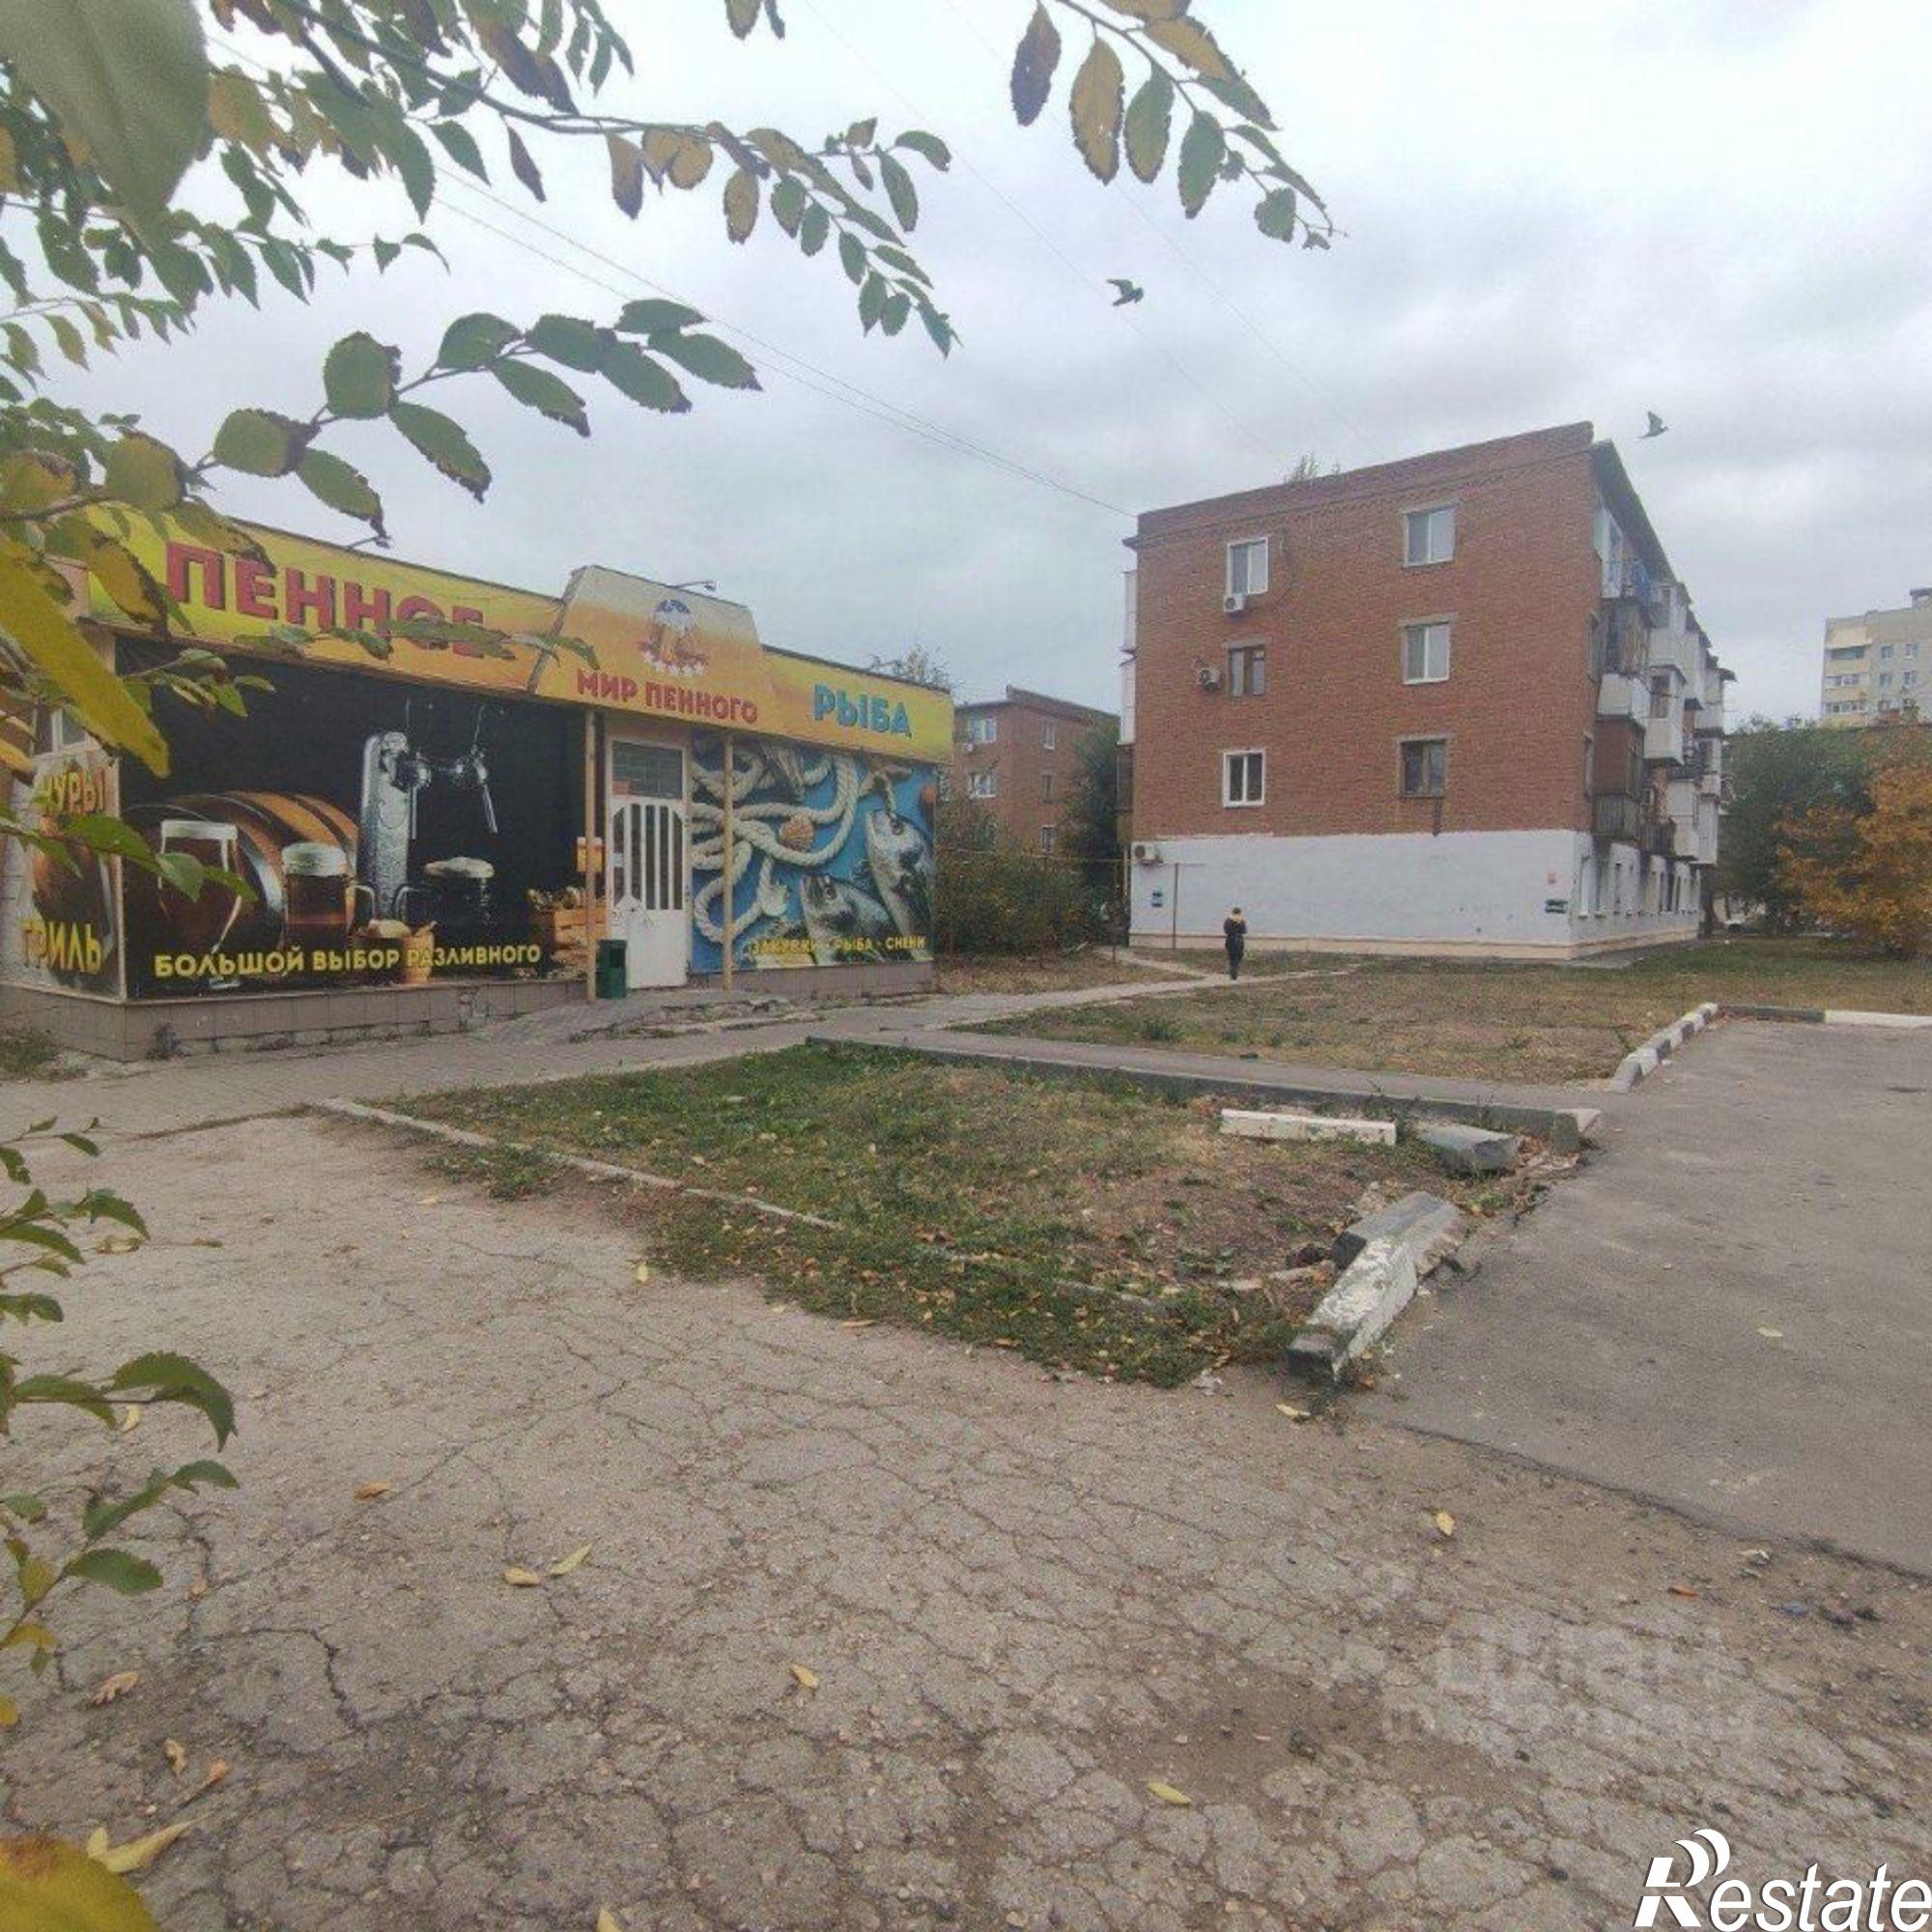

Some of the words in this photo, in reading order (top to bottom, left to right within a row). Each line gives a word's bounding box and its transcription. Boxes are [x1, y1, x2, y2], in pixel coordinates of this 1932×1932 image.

[166, 541, 485, 658] ПЕННОЕ
[577, 668, 639, 702] МИР
[645, 681, 758, 724] ПЕННОГО
[813, 683, 913, 738] РЫБА
[21, 920, 101, 976] ГРИЛЬ
[155, 945, 304, 979] БОЛЬШОЙ
[312, 949, 400, 972] ВЫБОР
[407, 944, 541, 968] РАЗЛИВНОГО
